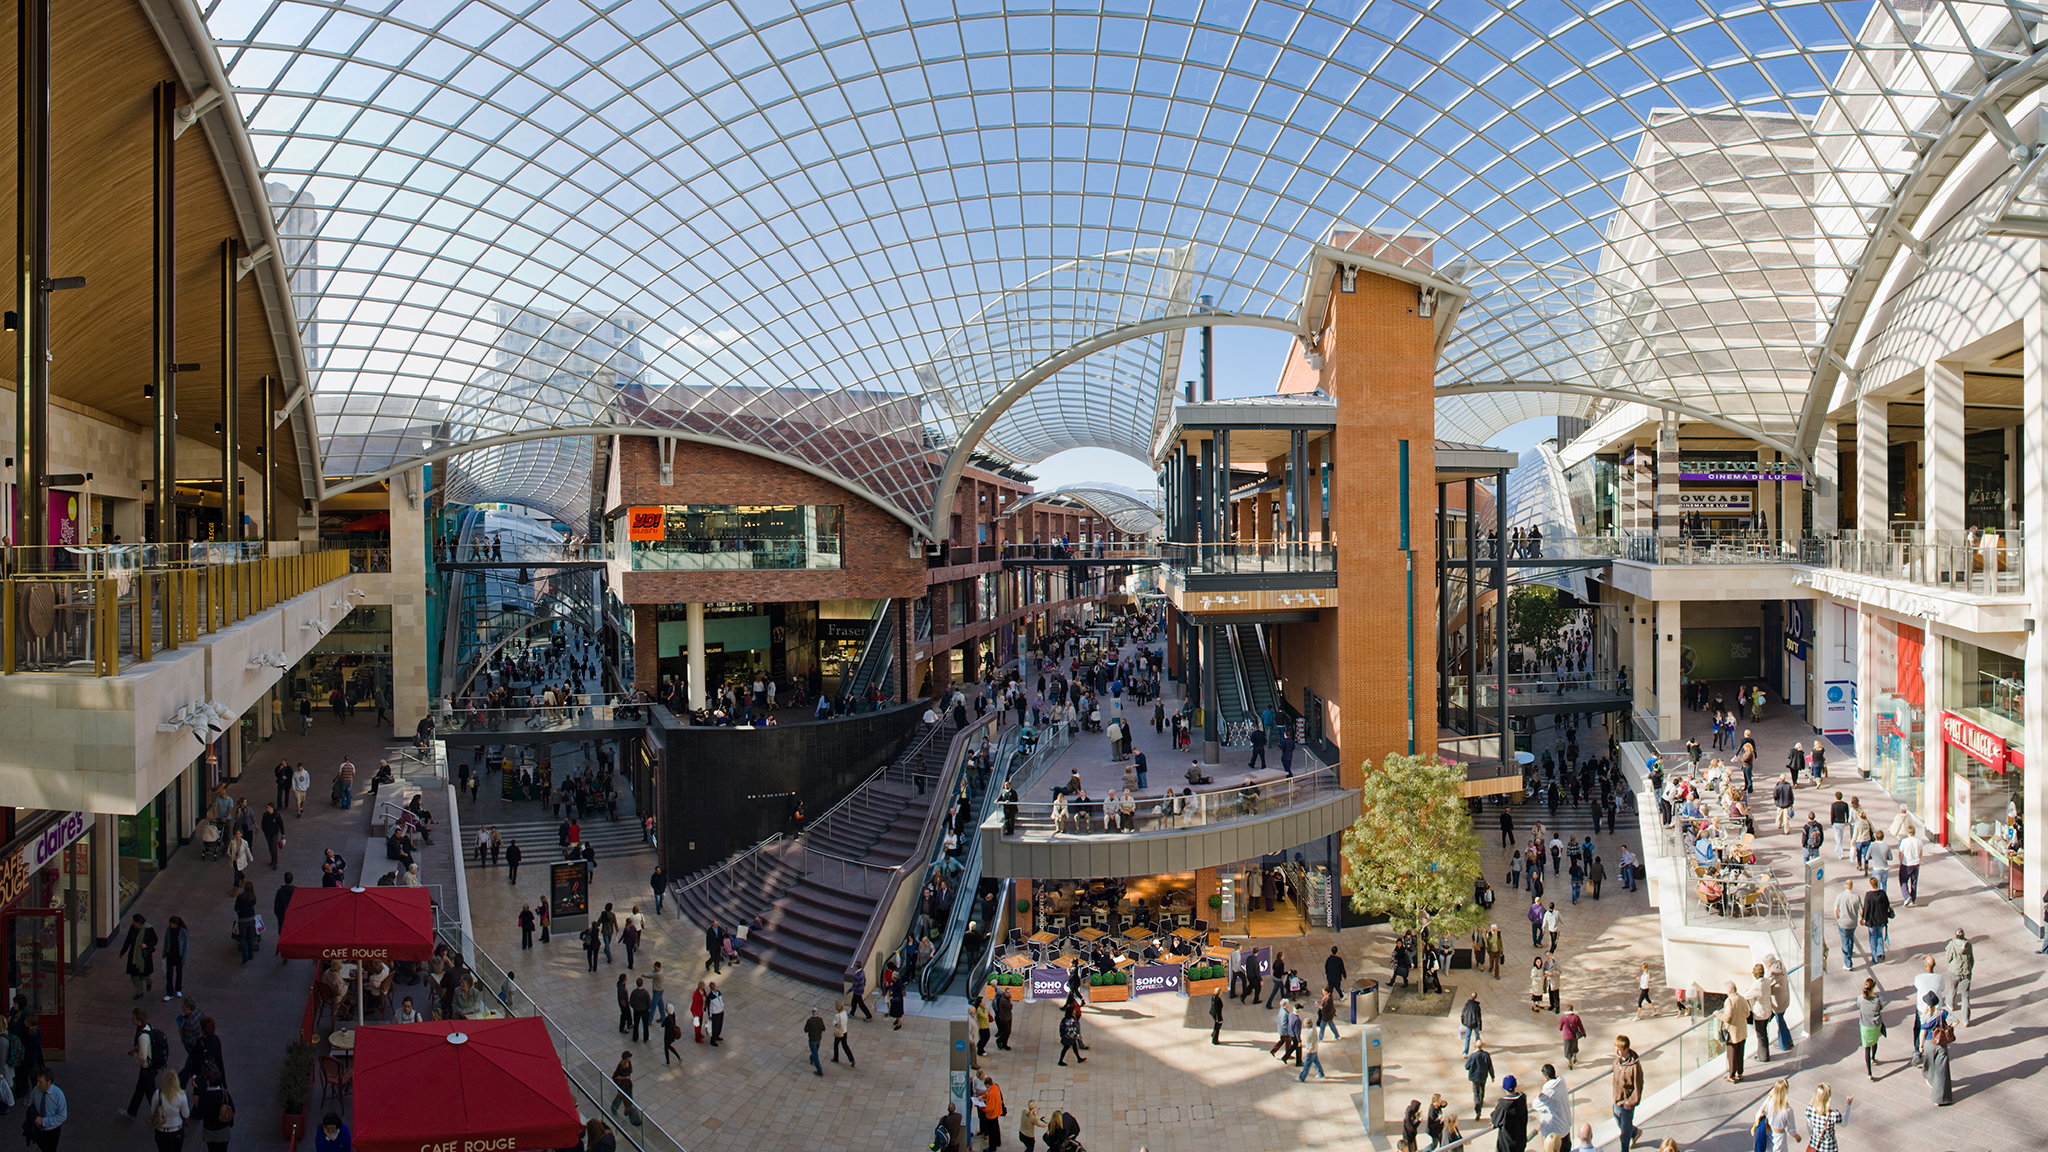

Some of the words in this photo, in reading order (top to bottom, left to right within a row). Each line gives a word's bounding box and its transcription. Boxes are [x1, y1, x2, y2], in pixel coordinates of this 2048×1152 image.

[1680, 461, 1800, 471] SHOWCAS
[633, 513, 662, 528] YO!
[37, 812, 83, 864] claire's
[0, 862, 30, 908] OUGE
[352, 948, 388, 958] ROUGE
[1034, 981, 1062, 989] SOHO
[1136, 976, 1164, 986] SOHO
[464, 1138, 516, 1152] ROUGE
